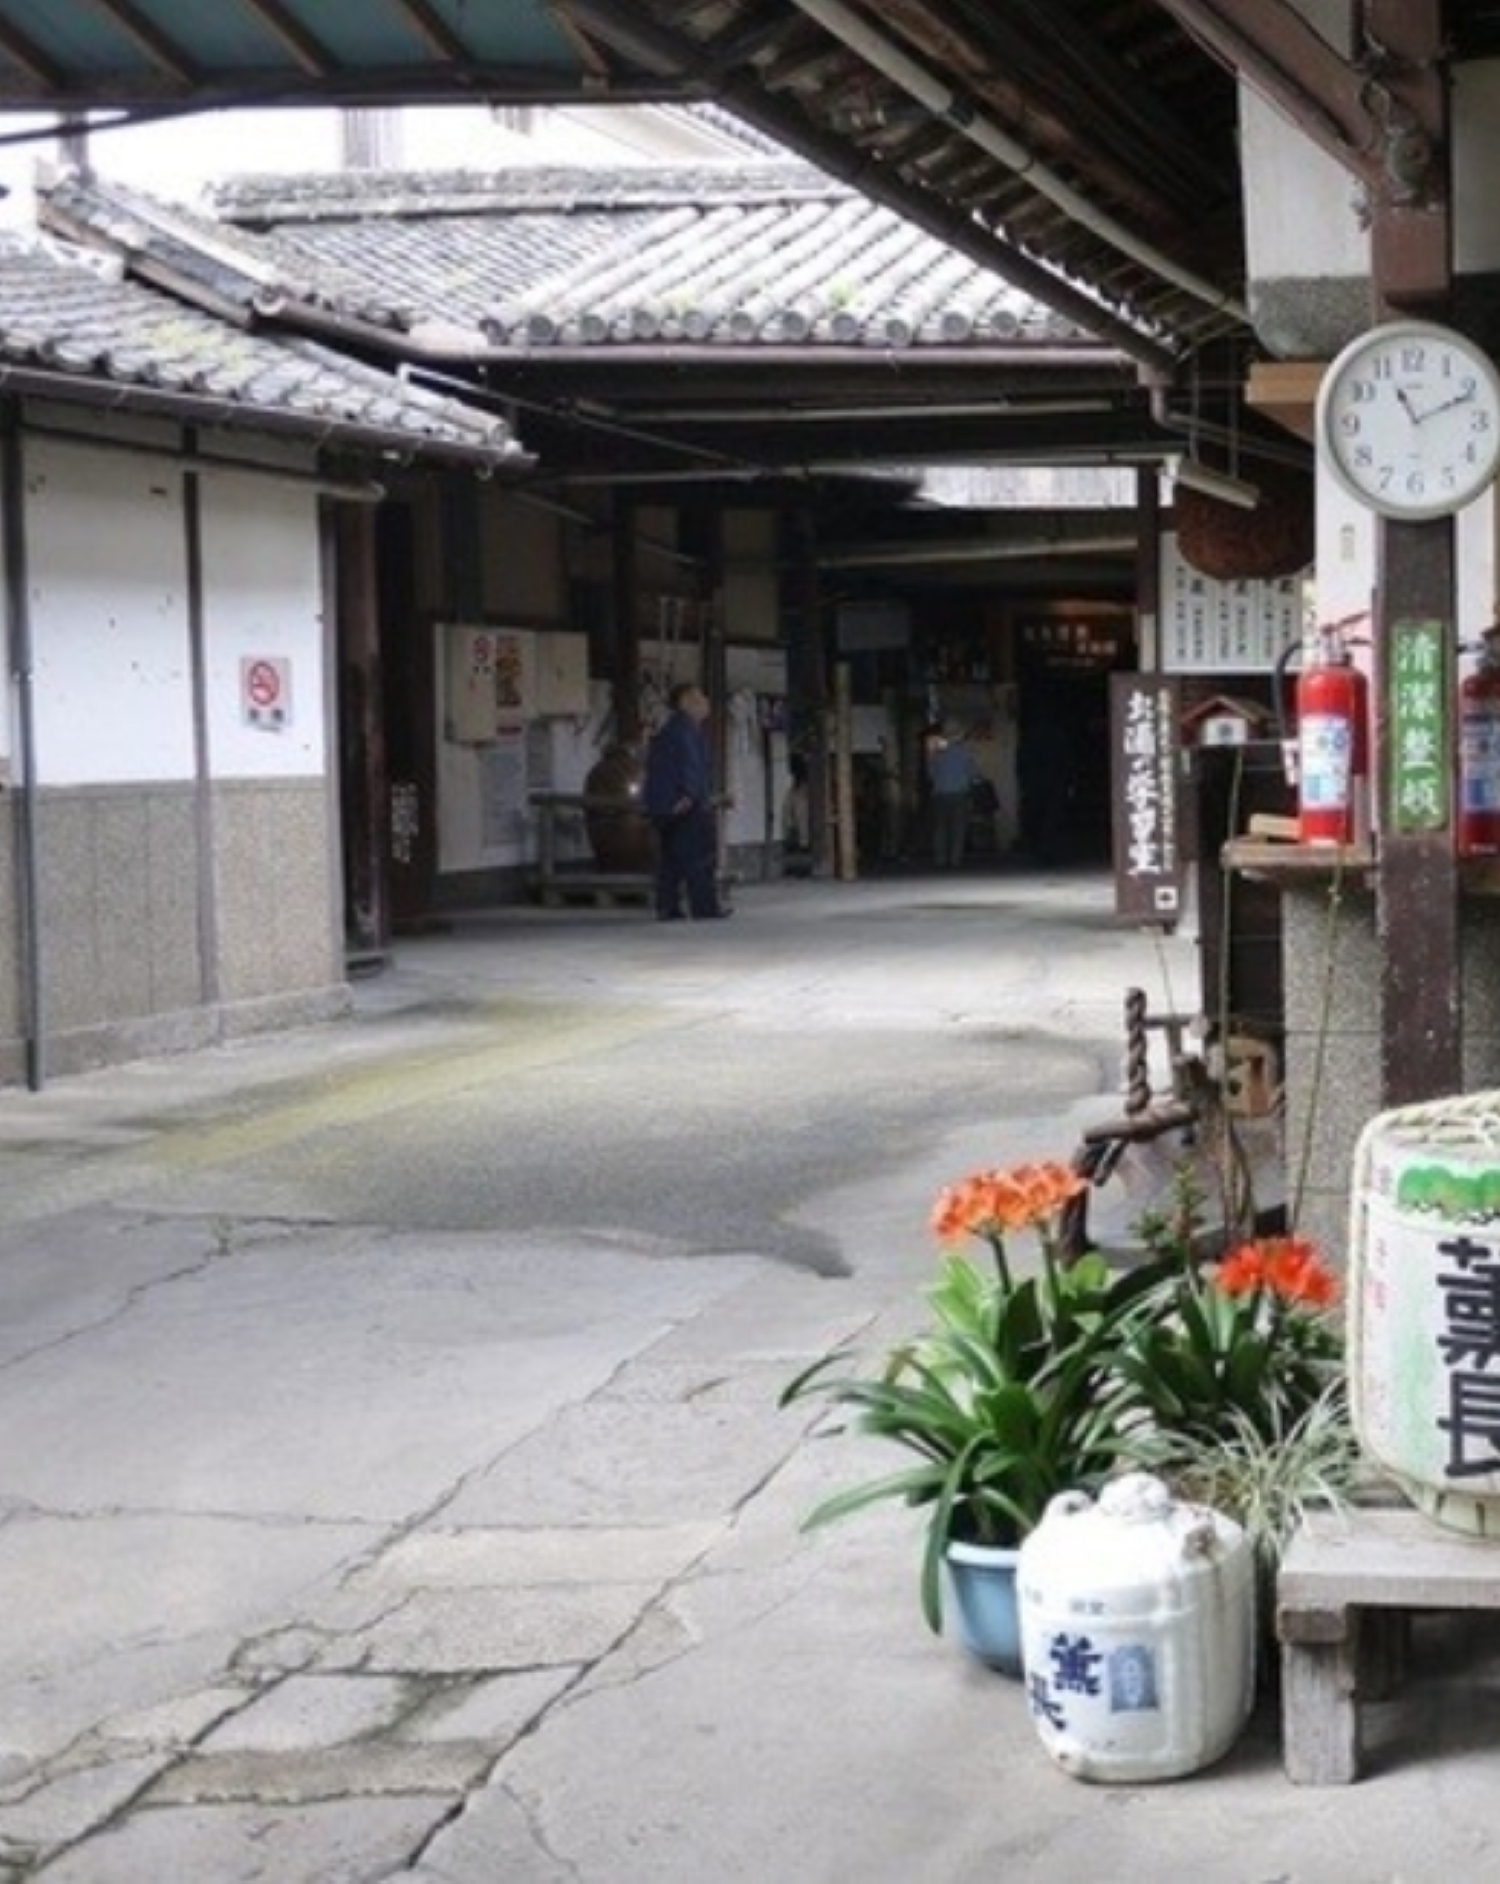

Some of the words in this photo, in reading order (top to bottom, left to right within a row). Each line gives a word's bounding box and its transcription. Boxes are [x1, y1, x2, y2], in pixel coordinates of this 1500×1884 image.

[1373, 355, 1391, 379] 11
[1400, 347, 1425, 372] 12
[1341, 413, 1360, 435] 9
[1470, 411, 1488, 432] 3
[1354, 445, 1372, 467] 8
[1379, 466, 1395, 490] 7
[1406, 472, 1425, 493] 6
[1441, 466, 1456, 487] 5
